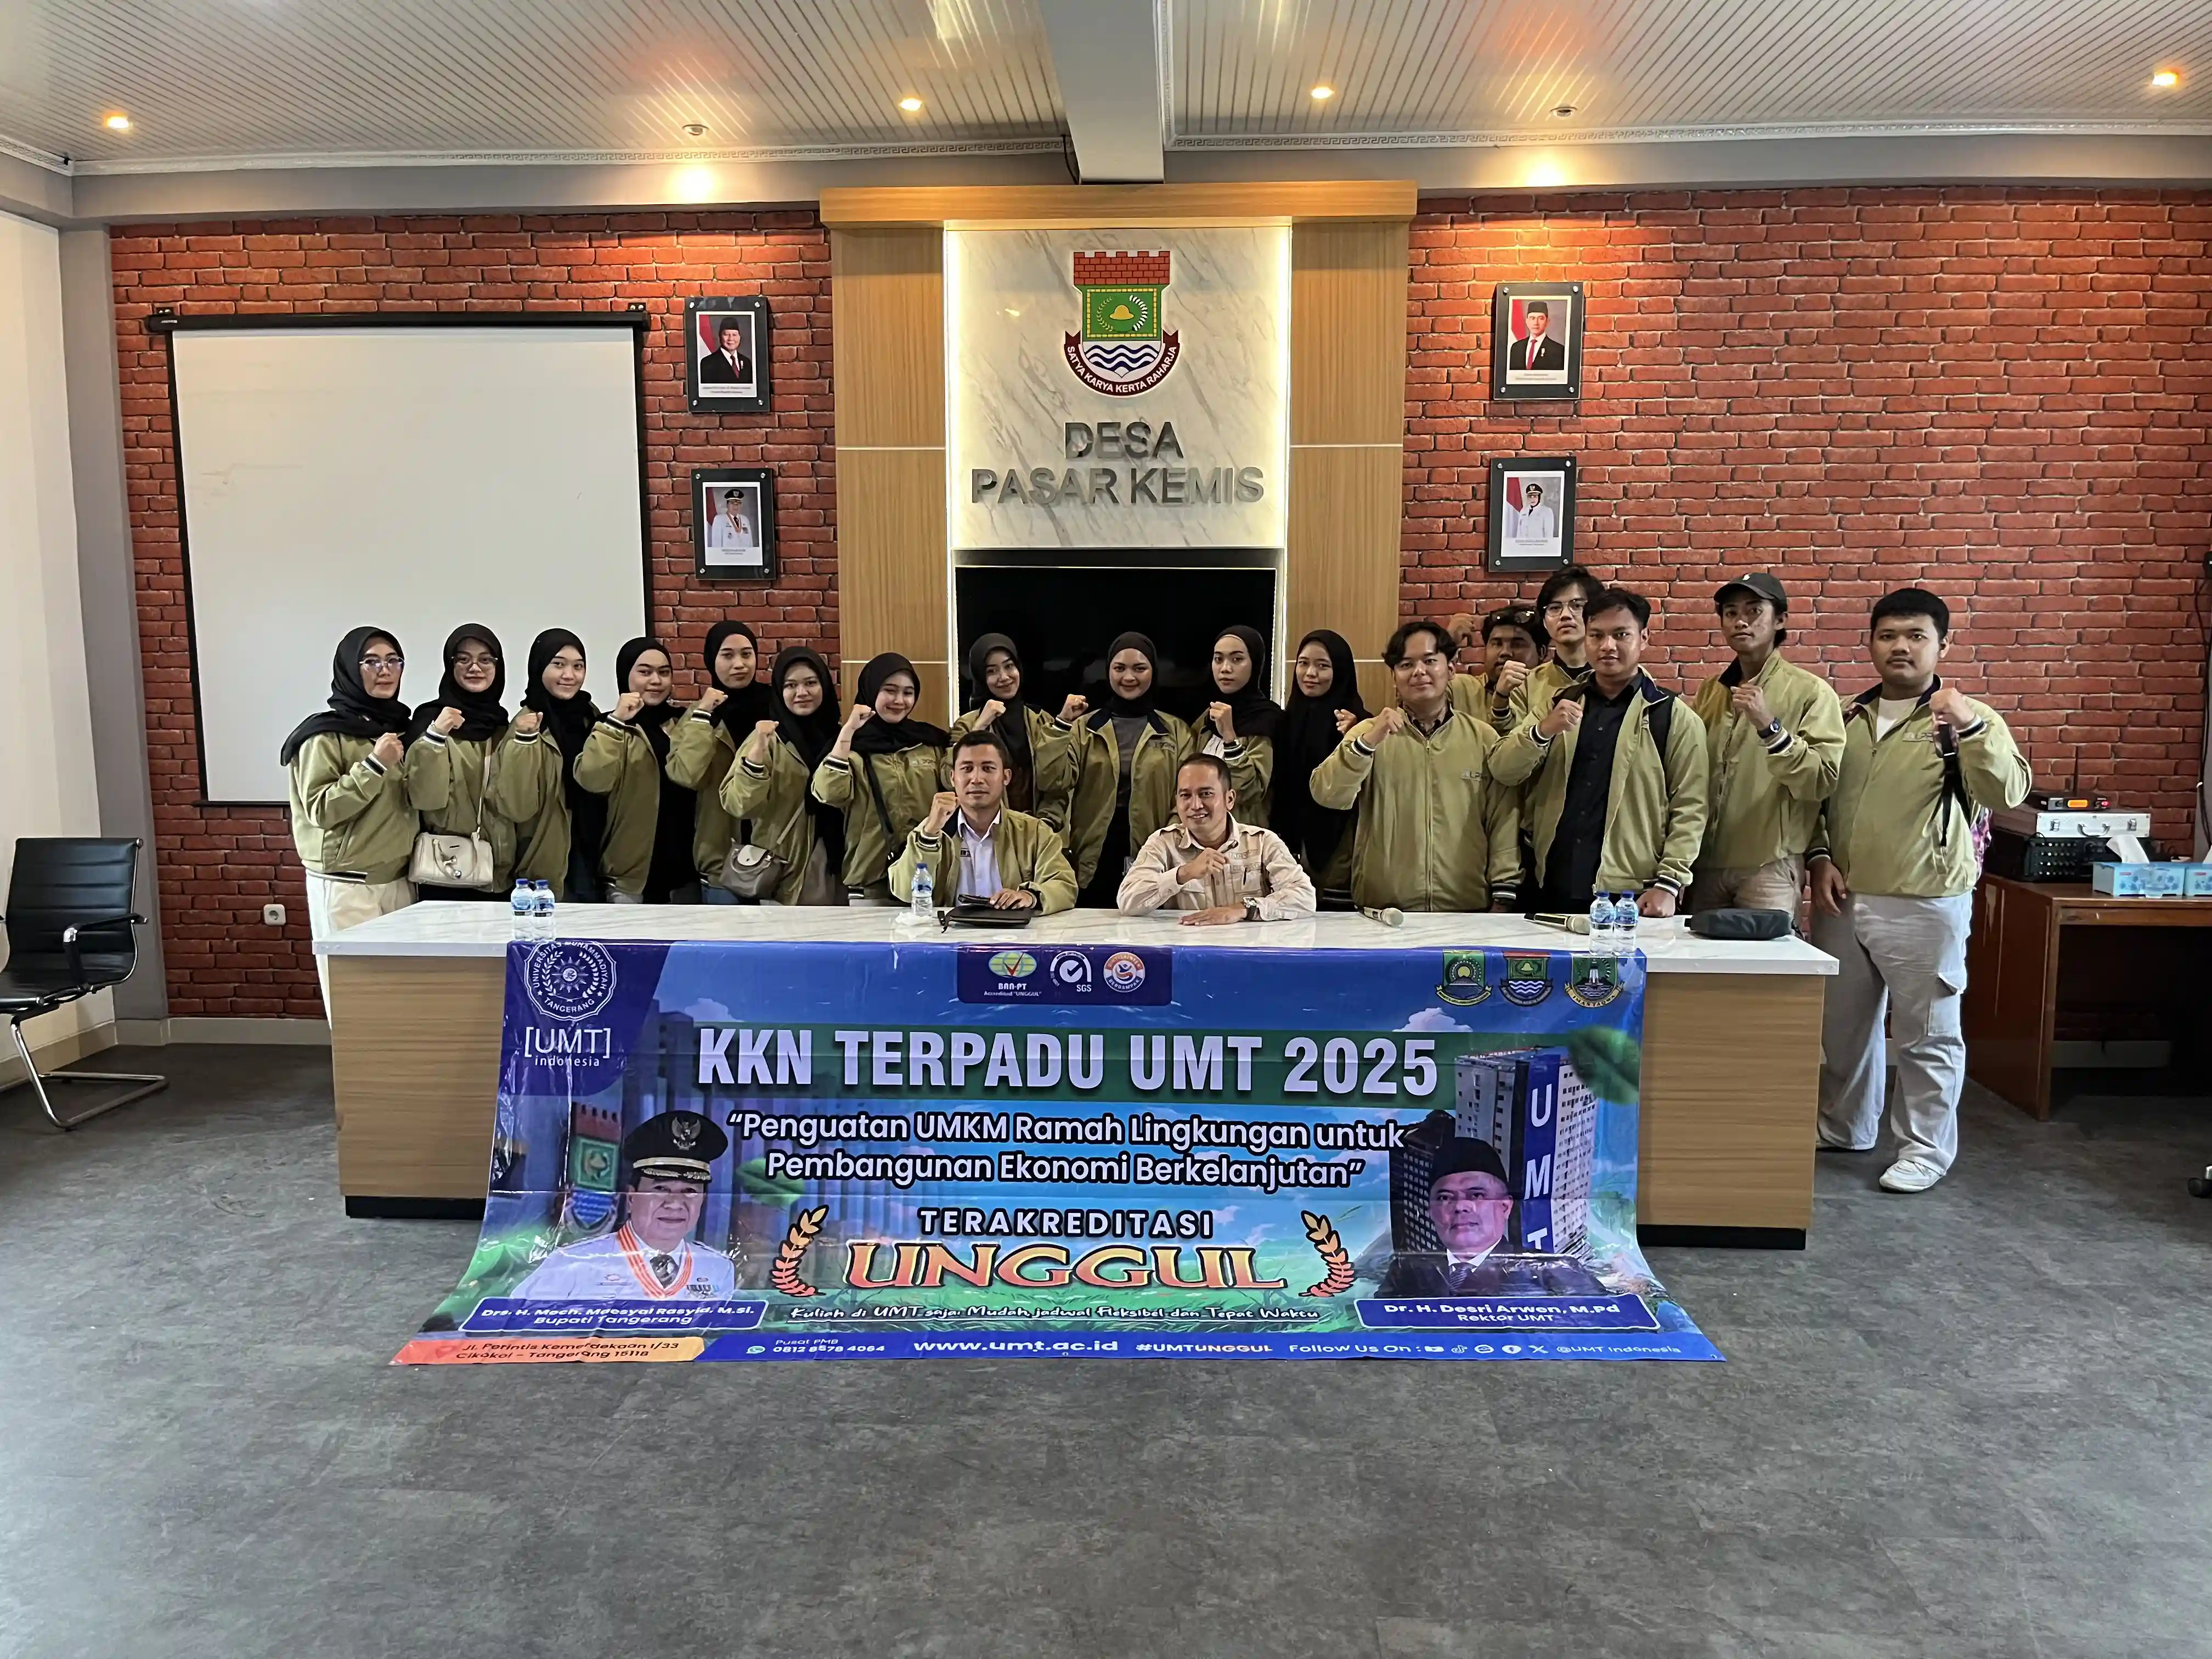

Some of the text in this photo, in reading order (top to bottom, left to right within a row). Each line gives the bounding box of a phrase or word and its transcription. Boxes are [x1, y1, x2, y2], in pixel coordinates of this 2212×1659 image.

[1068, 346, 1177, 393] SATYA KARYA KERTA RAHARJA
[1064, 421, 1184, 459] DESA
[972, 467, 1265, 505] PASAR KEMIS
[533, 942, 562, 988] UNIVERSITAS
[544, 997, 595, 1013] TANGERANG
[535, 1055, 600, 1066] indonesia
[698, 1028, 1437, 1096] KKN TERPADU UMT 2025
[730, 1113, 1405, 1150] “Penguatan UMKM Ramah Lingkungan untuk
[768, 1152, 991, 1185] Pembangunan
[1002, 1153, 1127, 1181] Ekonomi
[921, 1210, 1211, 1237] TERAKREDITASI
[848, 1242, 1286, 1289] UNGGUL
[791, 1308, 845, 1318] Kuliah
[851, 1308, 866, 1317] di
[874, 1306, 925, 1317] UMT
[1032, 1307, 1090, 1318] jadwal
[1097, 1306, 1164, 1317] Fleksibel
[1170, 1308, 1200, 1317] dan
[1205, 1307, 1254, 1319] Tepat
[1261, 1308, 1318, 1318] Waktu
[1384, 1305, 1413, 1313] Dr.
[1417, 1305, 1437, 1313] H.
[1440, 1304, 1492, 1313] Desri
[1569, 1304, 1621, 1314] M.Pd
[533, 1315, 693, 1325] Bupati Tangerang
[1458, 1314, 1554, 1322] Rektor UMT
[541, 1342, 647, 1351] Kemerdekaan
[913, 1341, 1118, 1352] www.umt.ac.id
[1136, 1343, 1273, 1352] #UMTUNGGUL
[1289, 1344, 1350, 1353] Follow
[1355, 1344, 1379, 1353] Us
[1383, 1345, 1412, 1353] On
